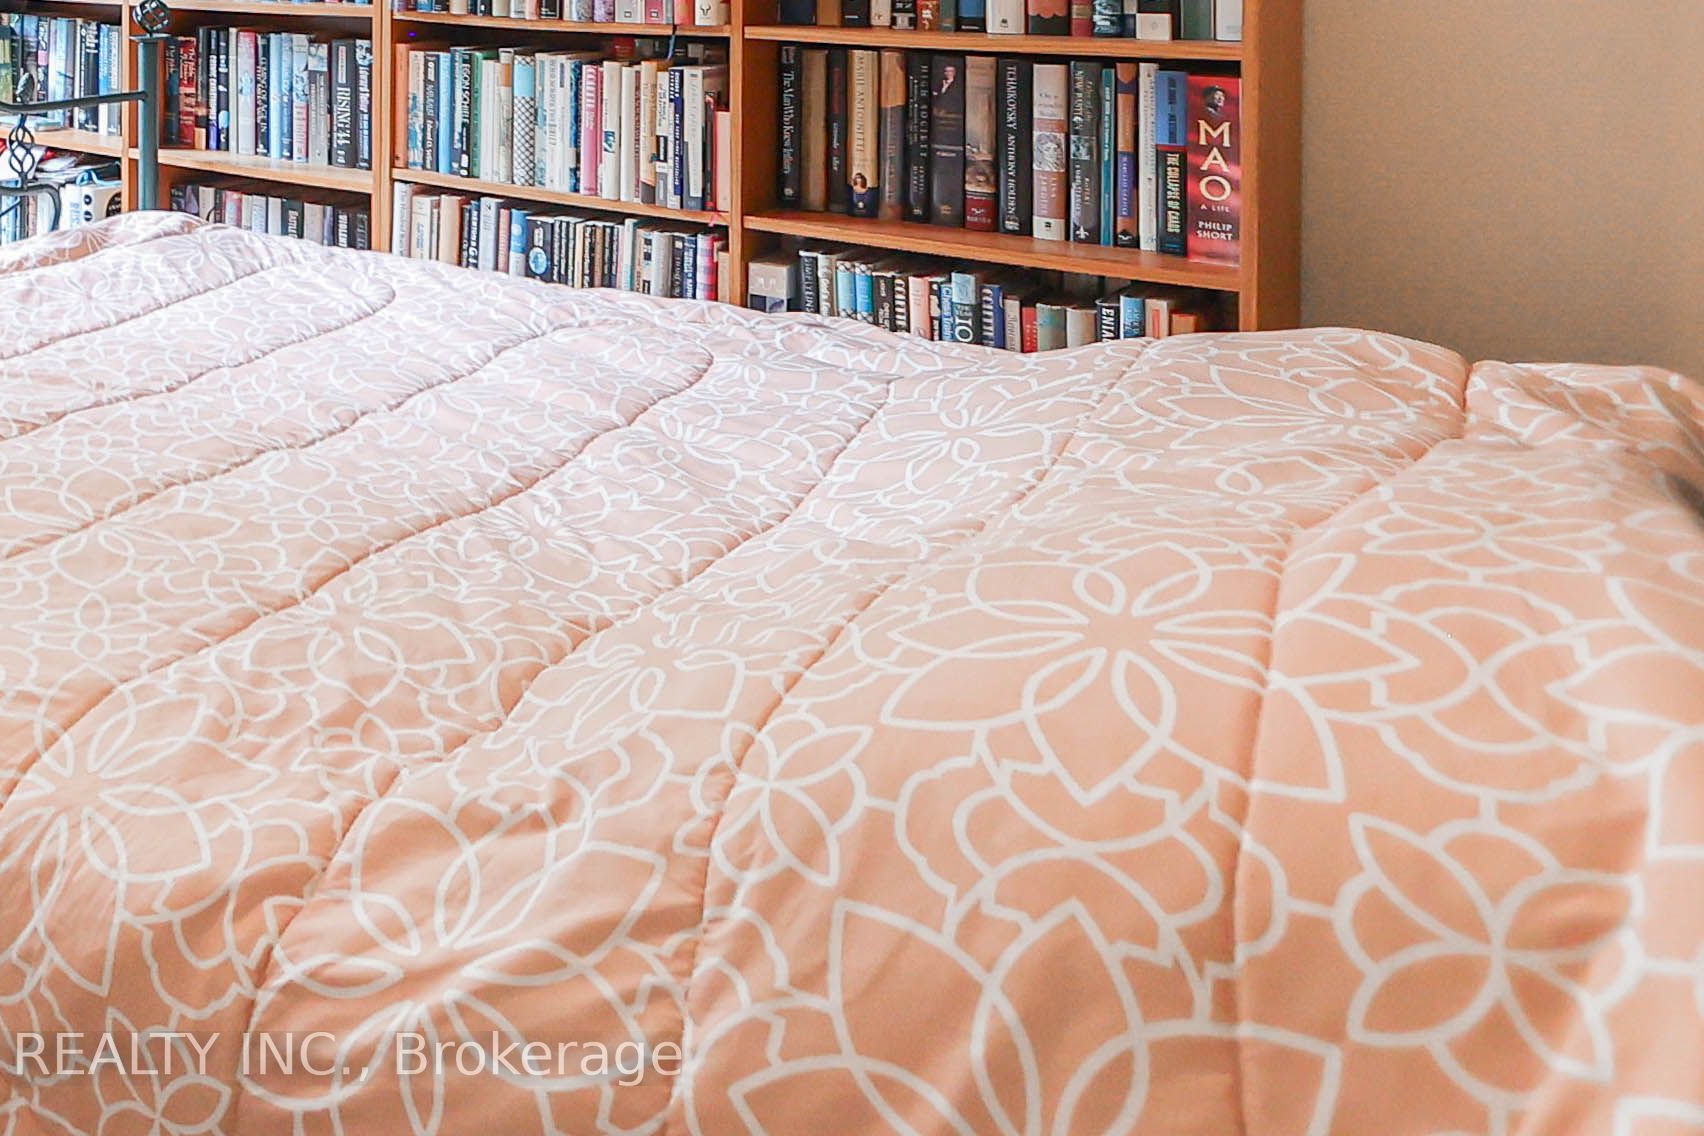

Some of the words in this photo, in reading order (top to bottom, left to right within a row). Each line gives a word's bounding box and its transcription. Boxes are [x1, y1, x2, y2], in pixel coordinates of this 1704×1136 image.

[1006, 66, 1017, 129] TCHAIKOVSKY
[1006, 133, 1017, 176] ANTHONY
[1166, 153, 1180, 166] THE
[1197, 120, 1232, 201] MAO
[1166, 167, 1180, 199] COLLAPSE
[1166, 199, 1180, 210] OF
[1166, 210, 1180, 233] CHAOS
[1197, 220, 1232, 232] PHILIP
[1196, 230, 1233, 242] SHORT
